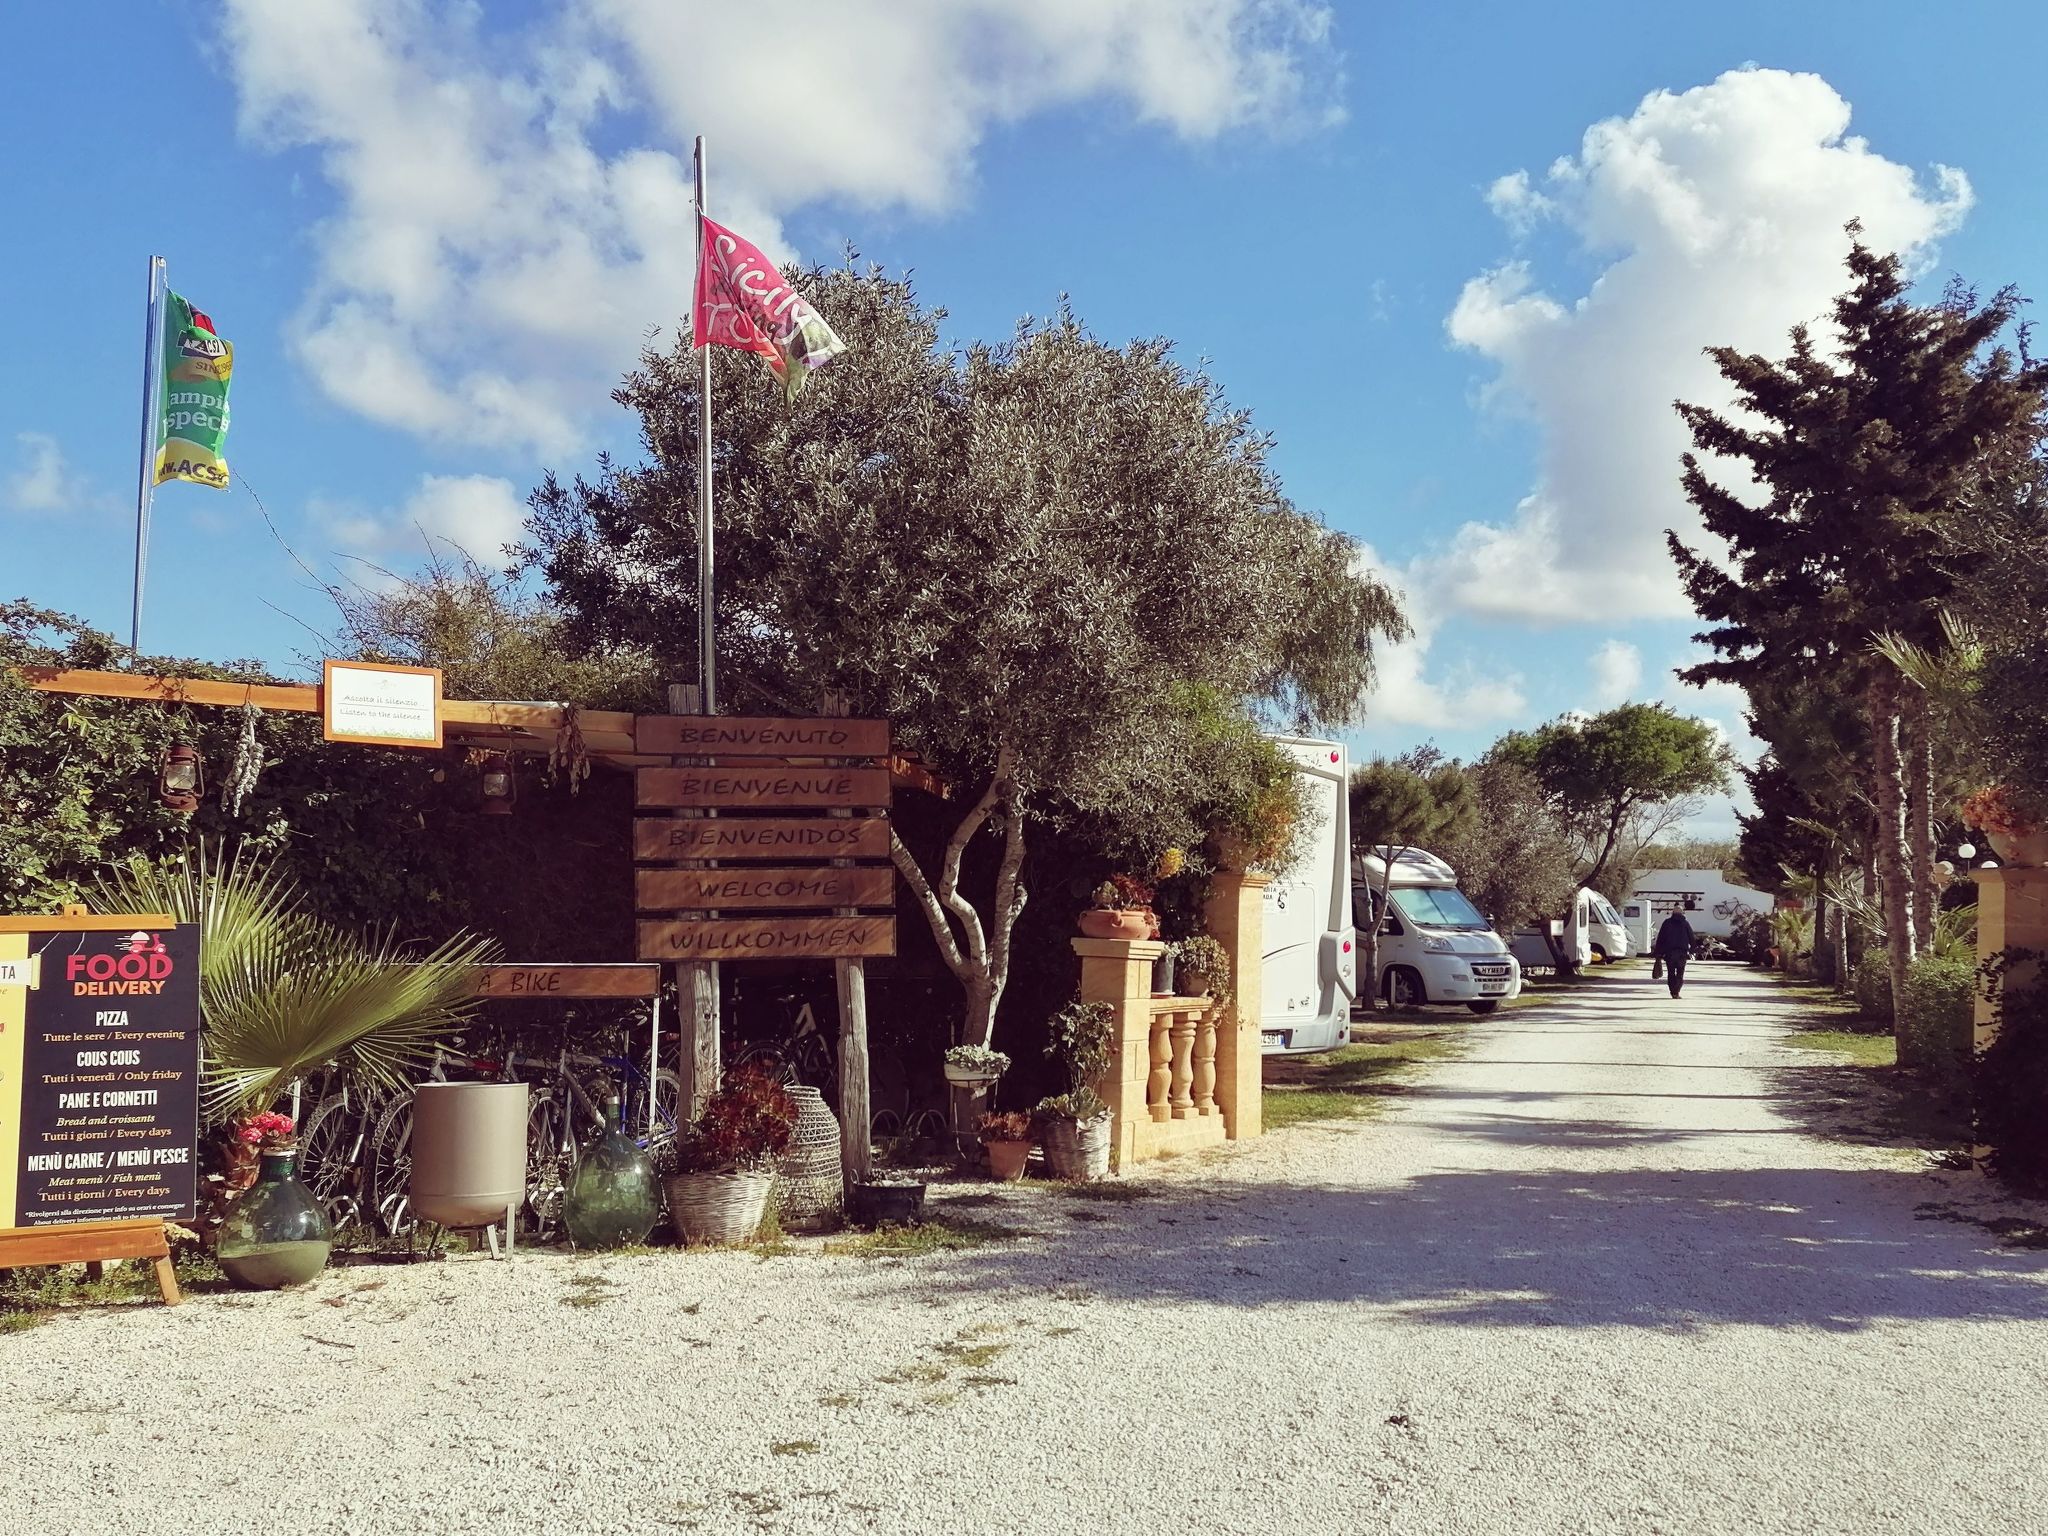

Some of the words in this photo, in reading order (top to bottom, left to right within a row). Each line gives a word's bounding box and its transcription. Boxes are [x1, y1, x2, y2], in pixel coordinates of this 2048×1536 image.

[379, 711, 391, 719] the
[680, 728, 848, 745] BENVENUTO
[681, 778, 853, 796] BIENVENUE
[668, 828, 860, 847] BIENVENIDOS
[697, 879, 840, 898] WELCOME
[670, 929, 866, 950] WILLKOMMEN
[66, 953, 173, 981] FOOD
[74, 981, 166, 996] DELIVERY
[511, 972, 560, 992] BIKE
[95, 1011, 129, 1026] PIZZA
[43, 1033, 71, 1042] Tutte
[73, 1033, 83, 1041] le
[114, 1031, 144, 1042] Every
[145, 1030, 185, 1040] evening
[77, 1051, 108, 1067] COUS
[109, 1050, 140, 1066] COUS
[42, 1074, 69, 1084] Tutti
[124, 1071, 150, 1083] Only
[151, 1070, 182, 1081] friday
[59, 1093, 91, 1109] PANE
[93, 1092, 100, 1107] E
[102, 1089, 158, 1106] CORNETTI
[56, 1118, 86, 1127] Bread
[87, 1116, 107, 1125] and
[109, 1114, 155, 1124] croissants
[42, 1132, 68, 1142] Tutti
[76, 1130, 107, 1142] giorni
[117, 1128, 147, 1139] Every
[148, 1126, 172, 1137] days
[28, 1152, 62, 1171] MENÙ
[64, 1152, 104, 1169] CARNE
[106, 1152, 115, 1168] /
[117, 1147, 151, 1167] MENÙ
[153, 1148, 189, 1165] PESCE
[48, 1177, 75, 1187] Meat
[112, 1173, 133, 1183] Fish
[40, 1191, 66, 1202] Tutti
[73, 1190, 105, 1202] giorni
[115, 1188, 145, 1199] Every
[147, 1186, 171, 1197] days
